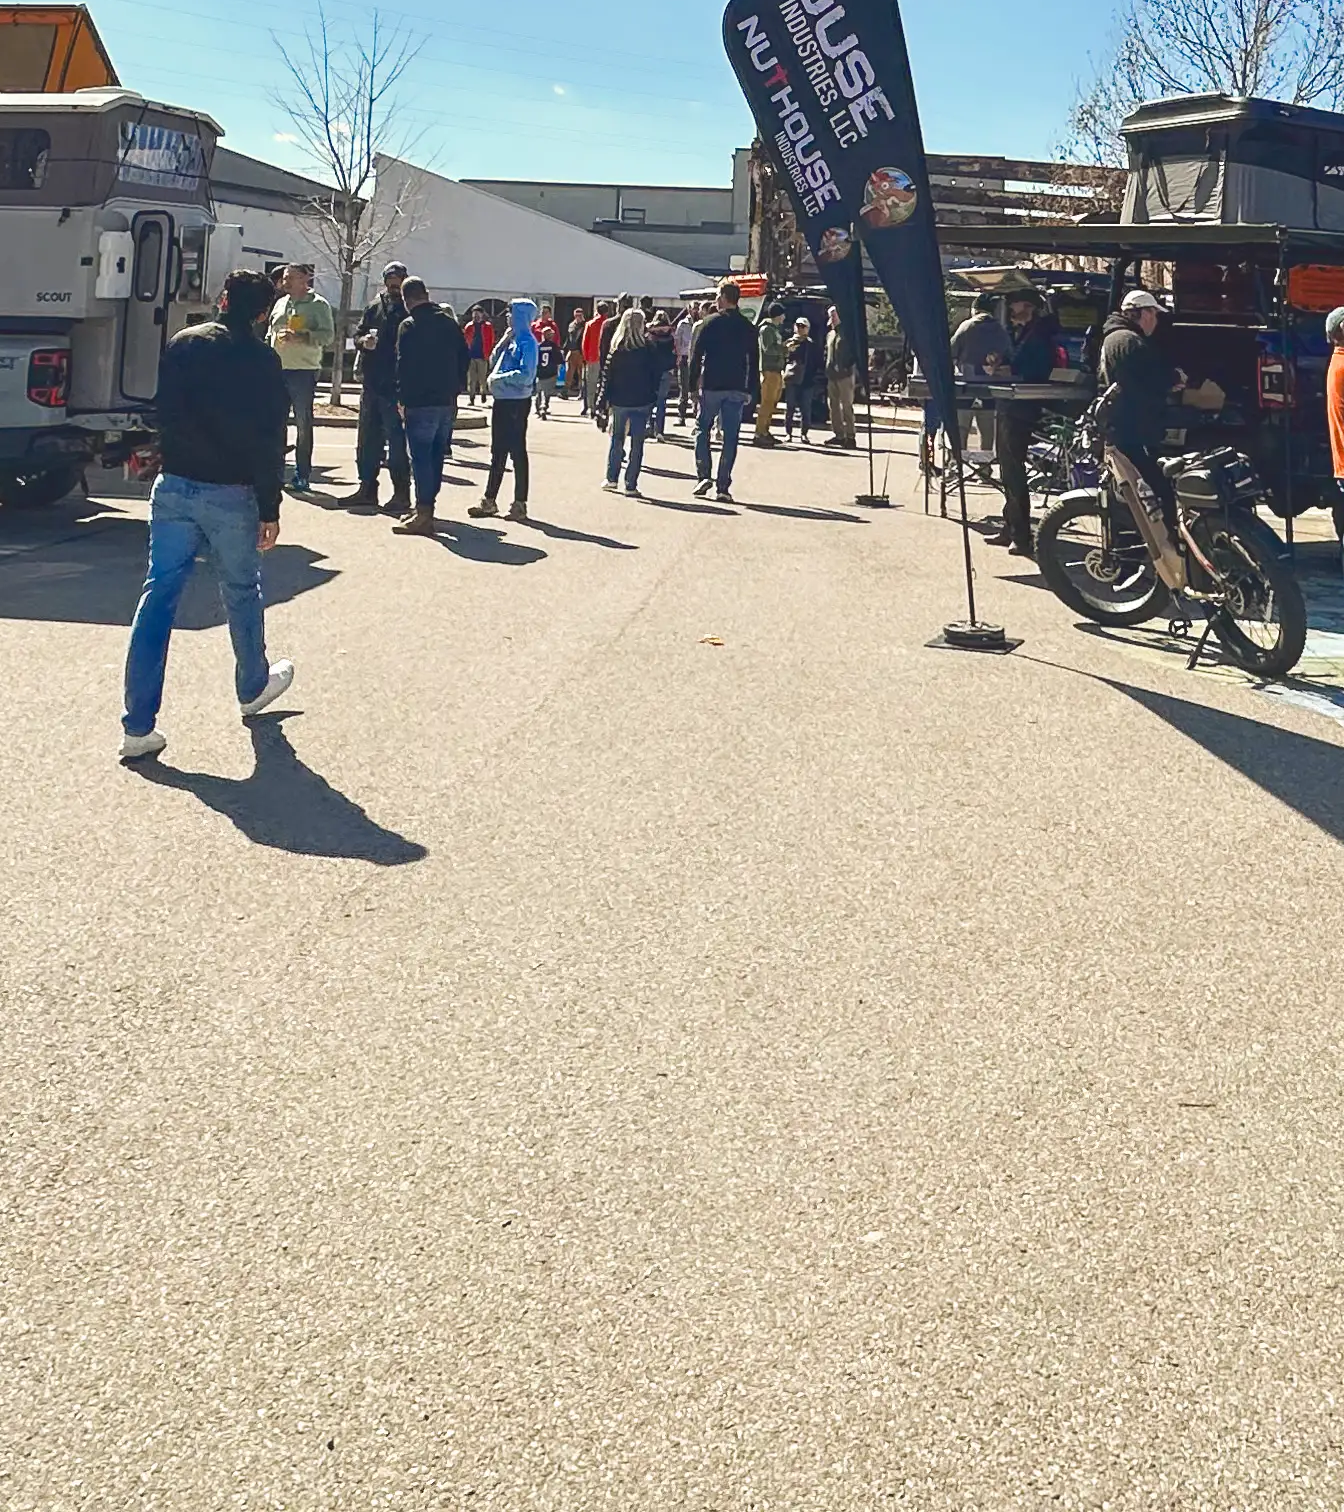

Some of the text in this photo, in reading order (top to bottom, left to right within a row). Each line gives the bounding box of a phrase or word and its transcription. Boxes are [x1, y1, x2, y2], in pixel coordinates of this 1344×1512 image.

[736, 14, 842, 212] NUTHOUSE
[829, 109, 858, 149] LLC
[773, 131, 821, 217] INDUSTRIES, LLC
[36, 292, 72, 302] SCOUT
[541, 352, 549, 367] 9
